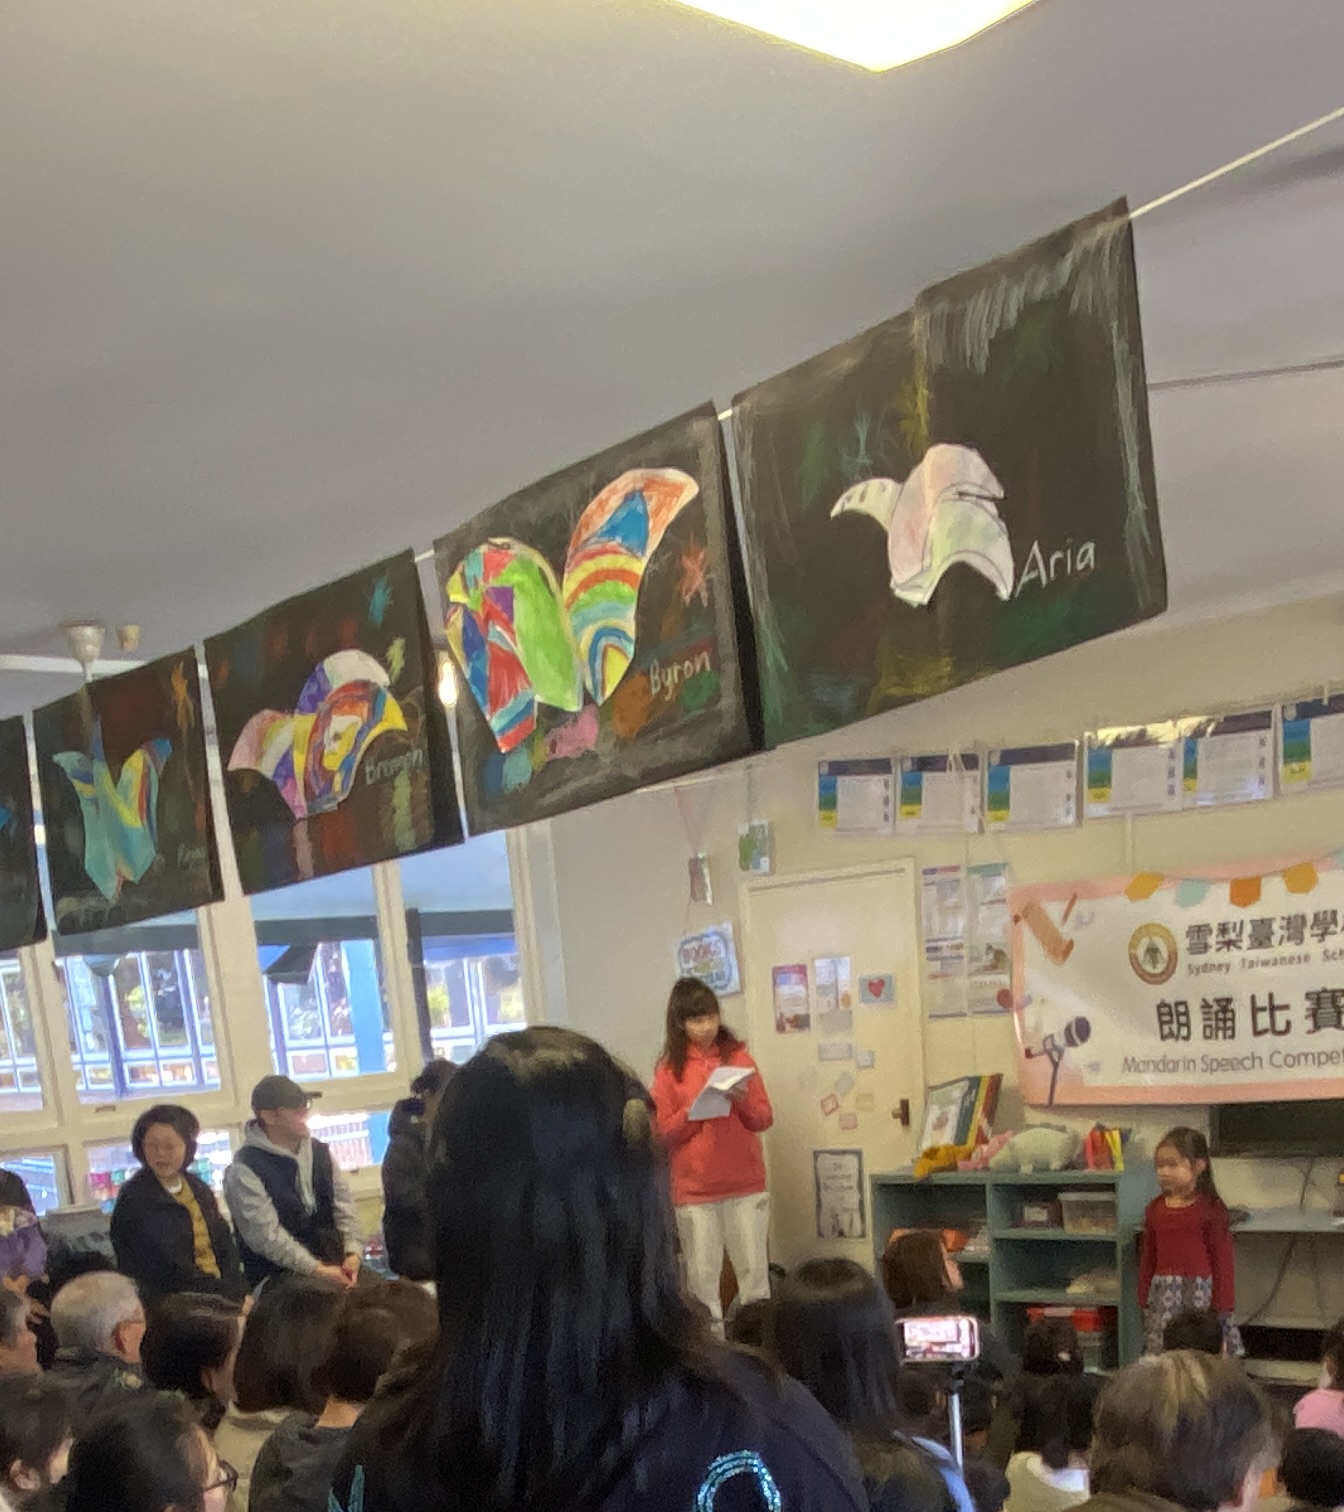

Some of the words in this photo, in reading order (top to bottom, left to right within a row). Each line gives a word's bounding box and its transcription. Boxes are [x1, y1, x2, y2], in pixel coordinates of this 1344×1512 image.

[1015, 537, 1096, 598] Aria
[650, 650, 710, 701] Byron
[1187, 961, 1232, 977] Sydney
[1240, 951, 1312, 970] Taiwanese
[1121, 1054, 1197, 1075] Mandarin
[1199, 1050, 1264, 1076] Speech
